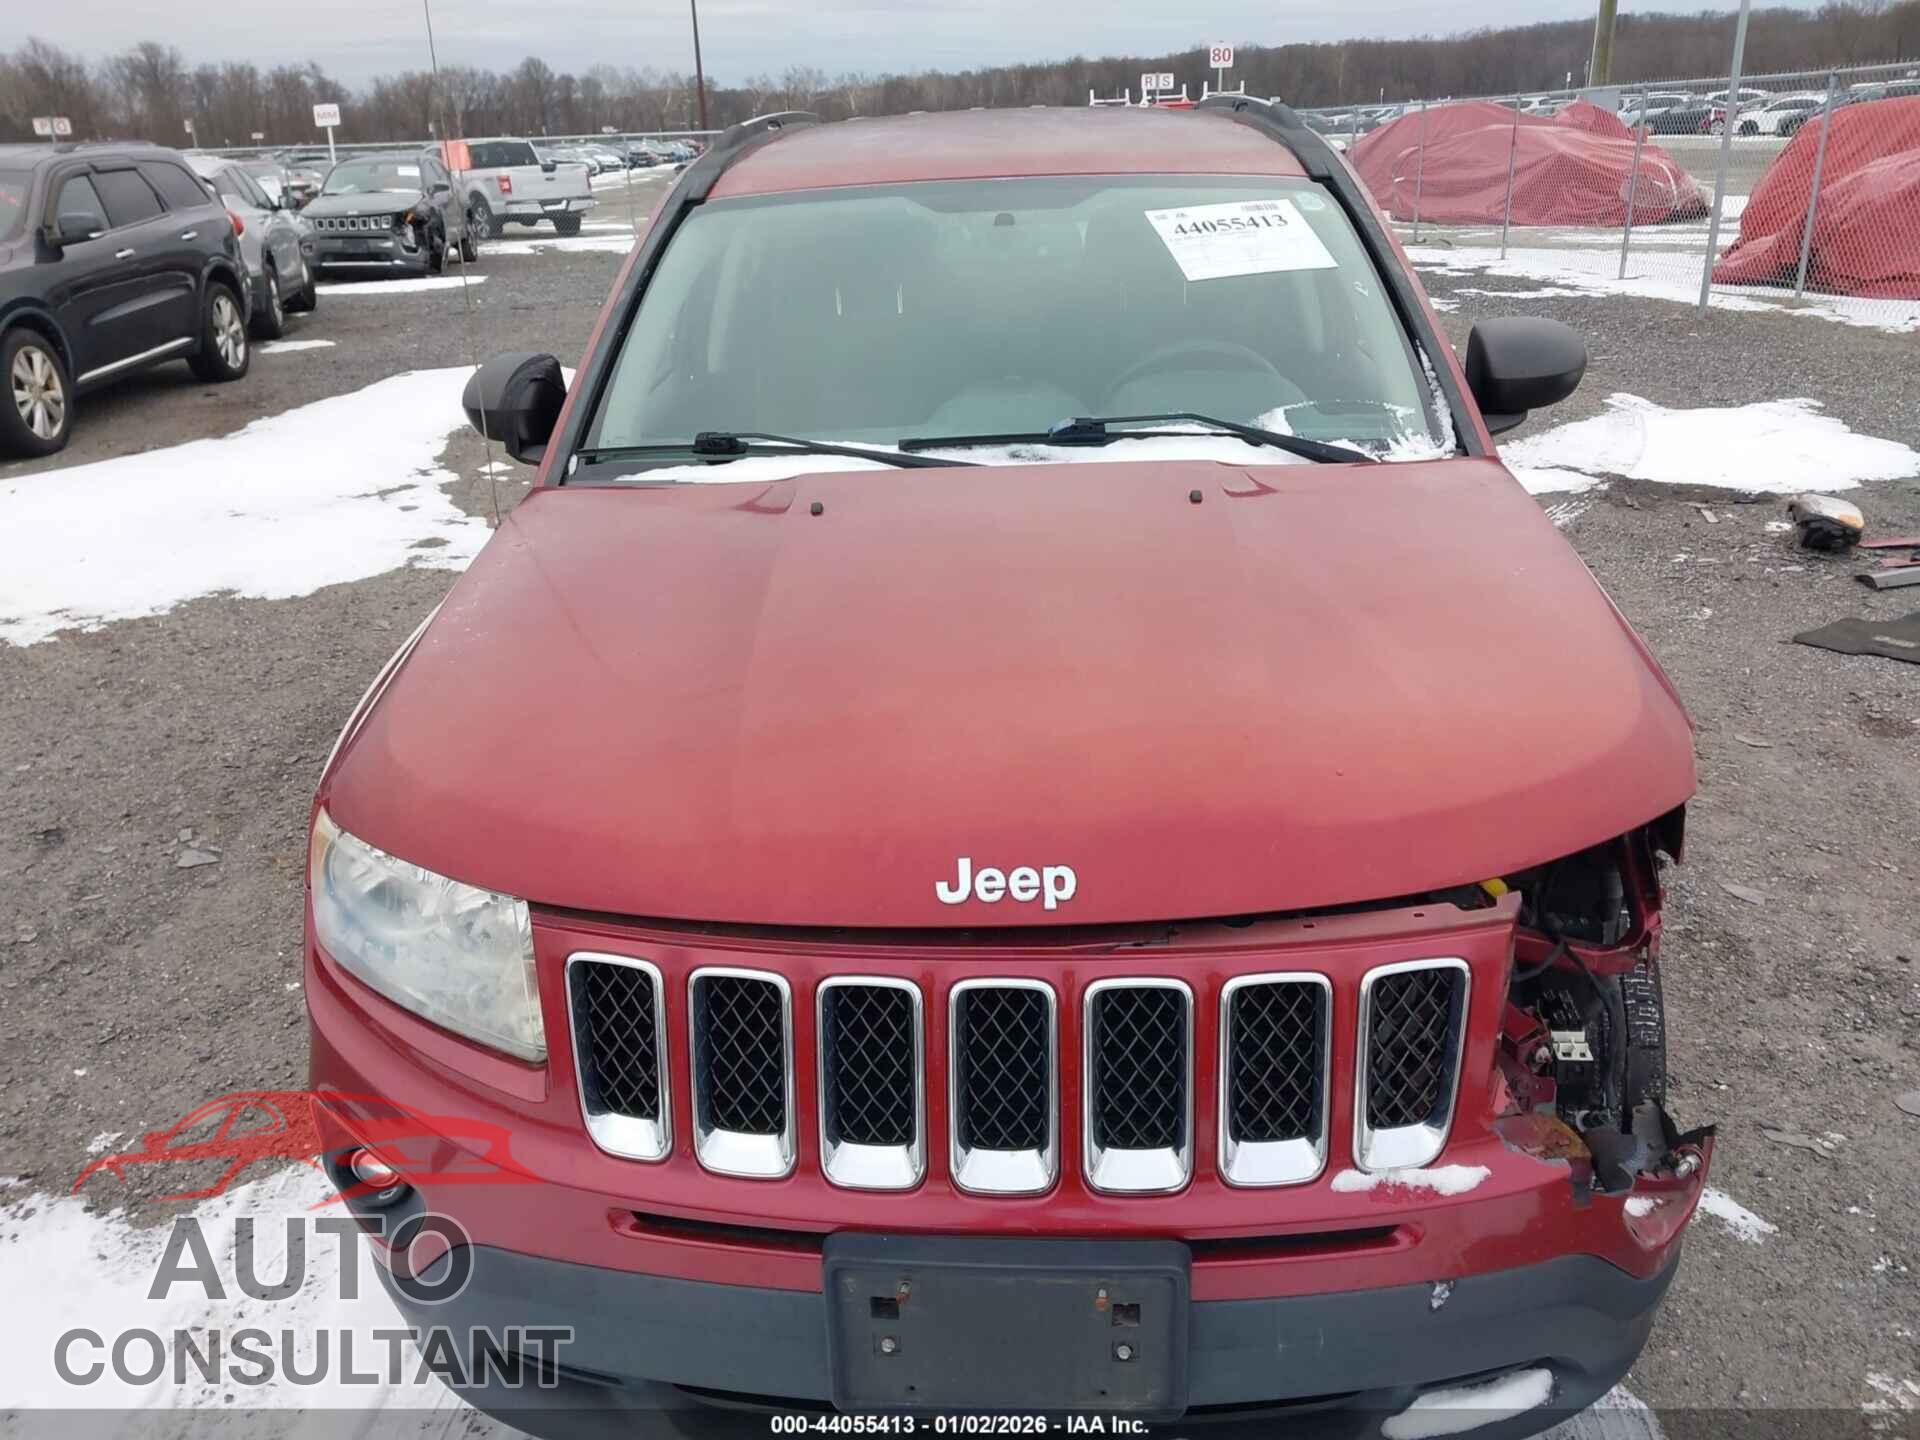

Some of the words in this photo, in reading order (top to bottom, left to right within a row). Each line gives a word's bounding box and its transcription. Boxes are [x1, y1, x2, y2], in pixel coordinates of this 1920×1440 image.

[1212, 48, 1231, 62] 80
[1144, 76, 1153, 86] R
[1162, 76, 1170, 86] S
[1173, 214, 1289, 236] 44055413
[935, 857, 1077, 910] Jeep
